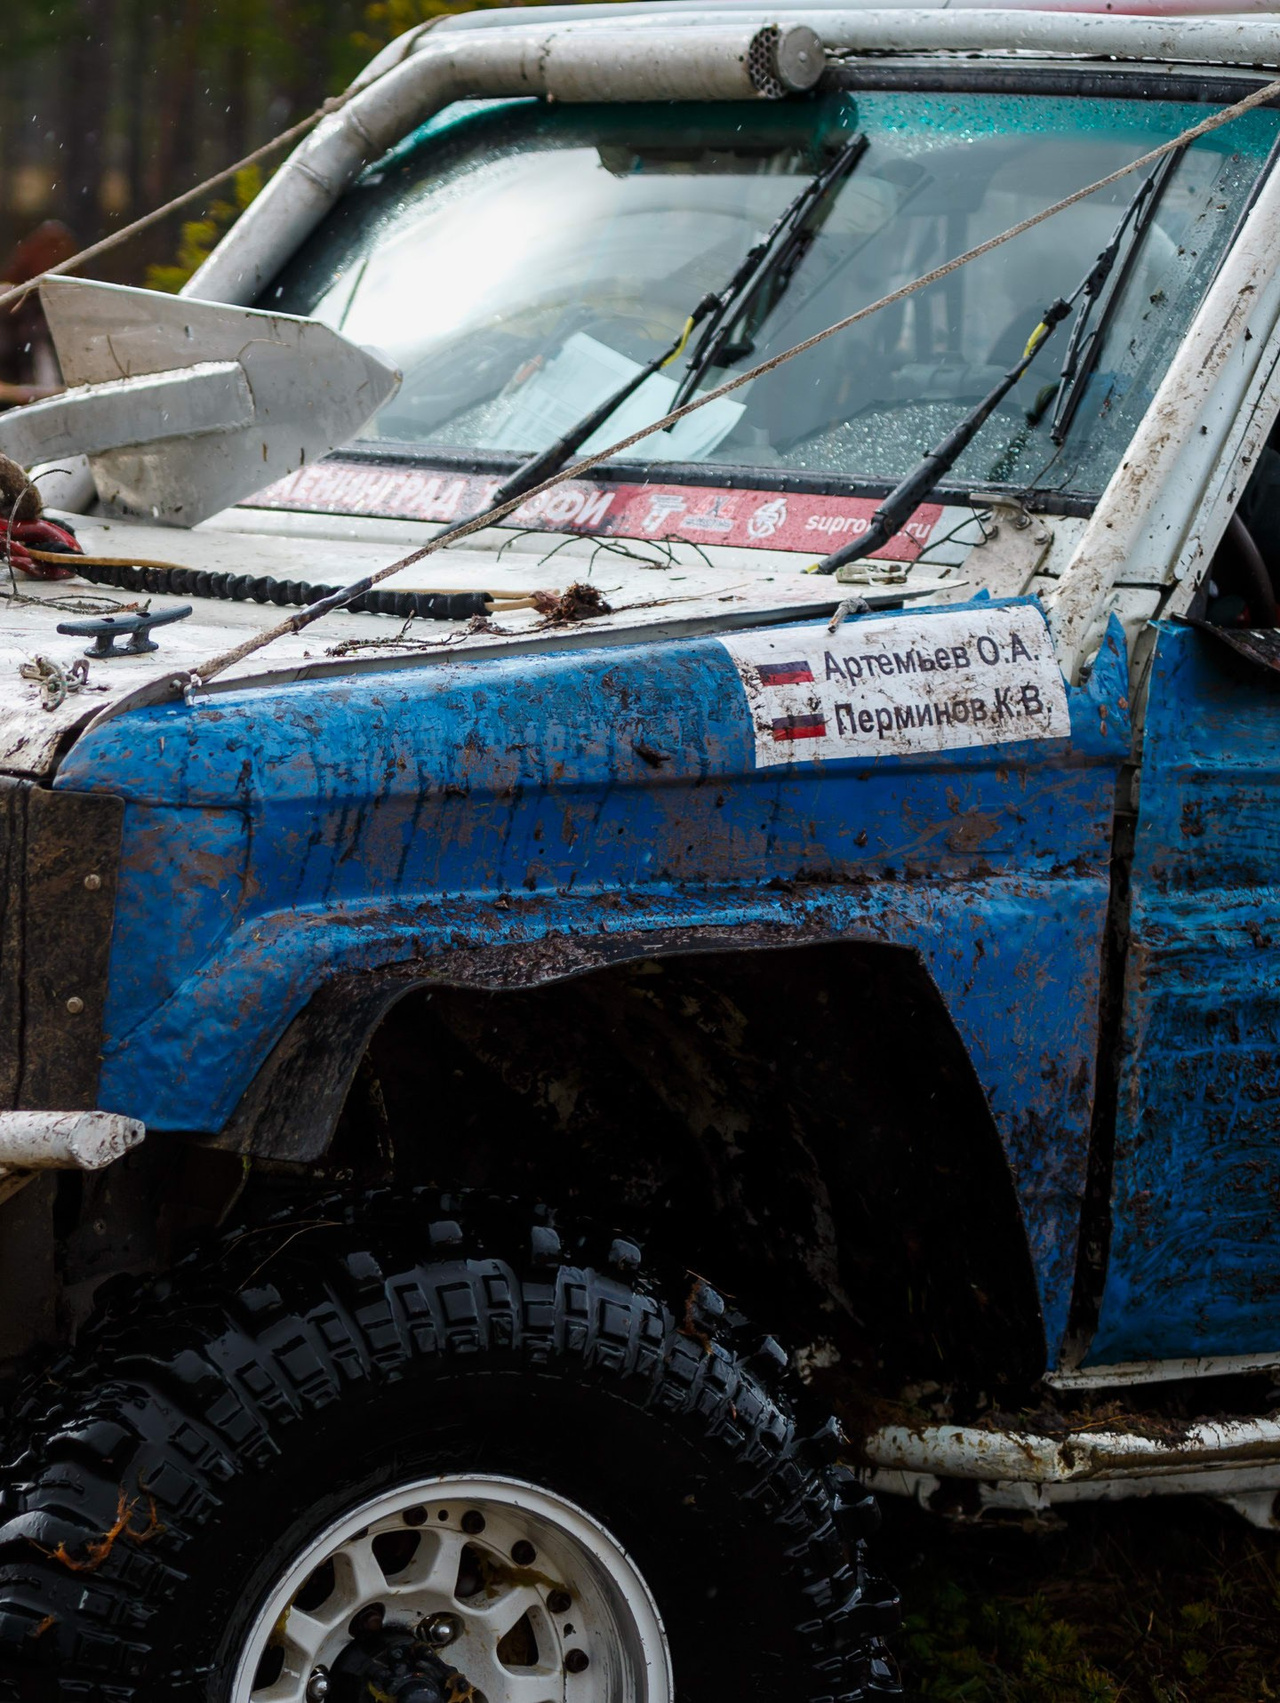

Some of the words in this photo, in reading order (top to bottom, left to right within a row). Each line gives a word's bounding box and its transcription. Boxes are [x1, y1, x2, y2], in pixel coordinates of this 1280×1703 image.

[268, 465, 466, 518] ЛЕНИНГРАД
[805, 514, 931, 539] supro.ru
[824, 645, 971, 687] Артемьев
[834, 698, 989, 740] Перминов
